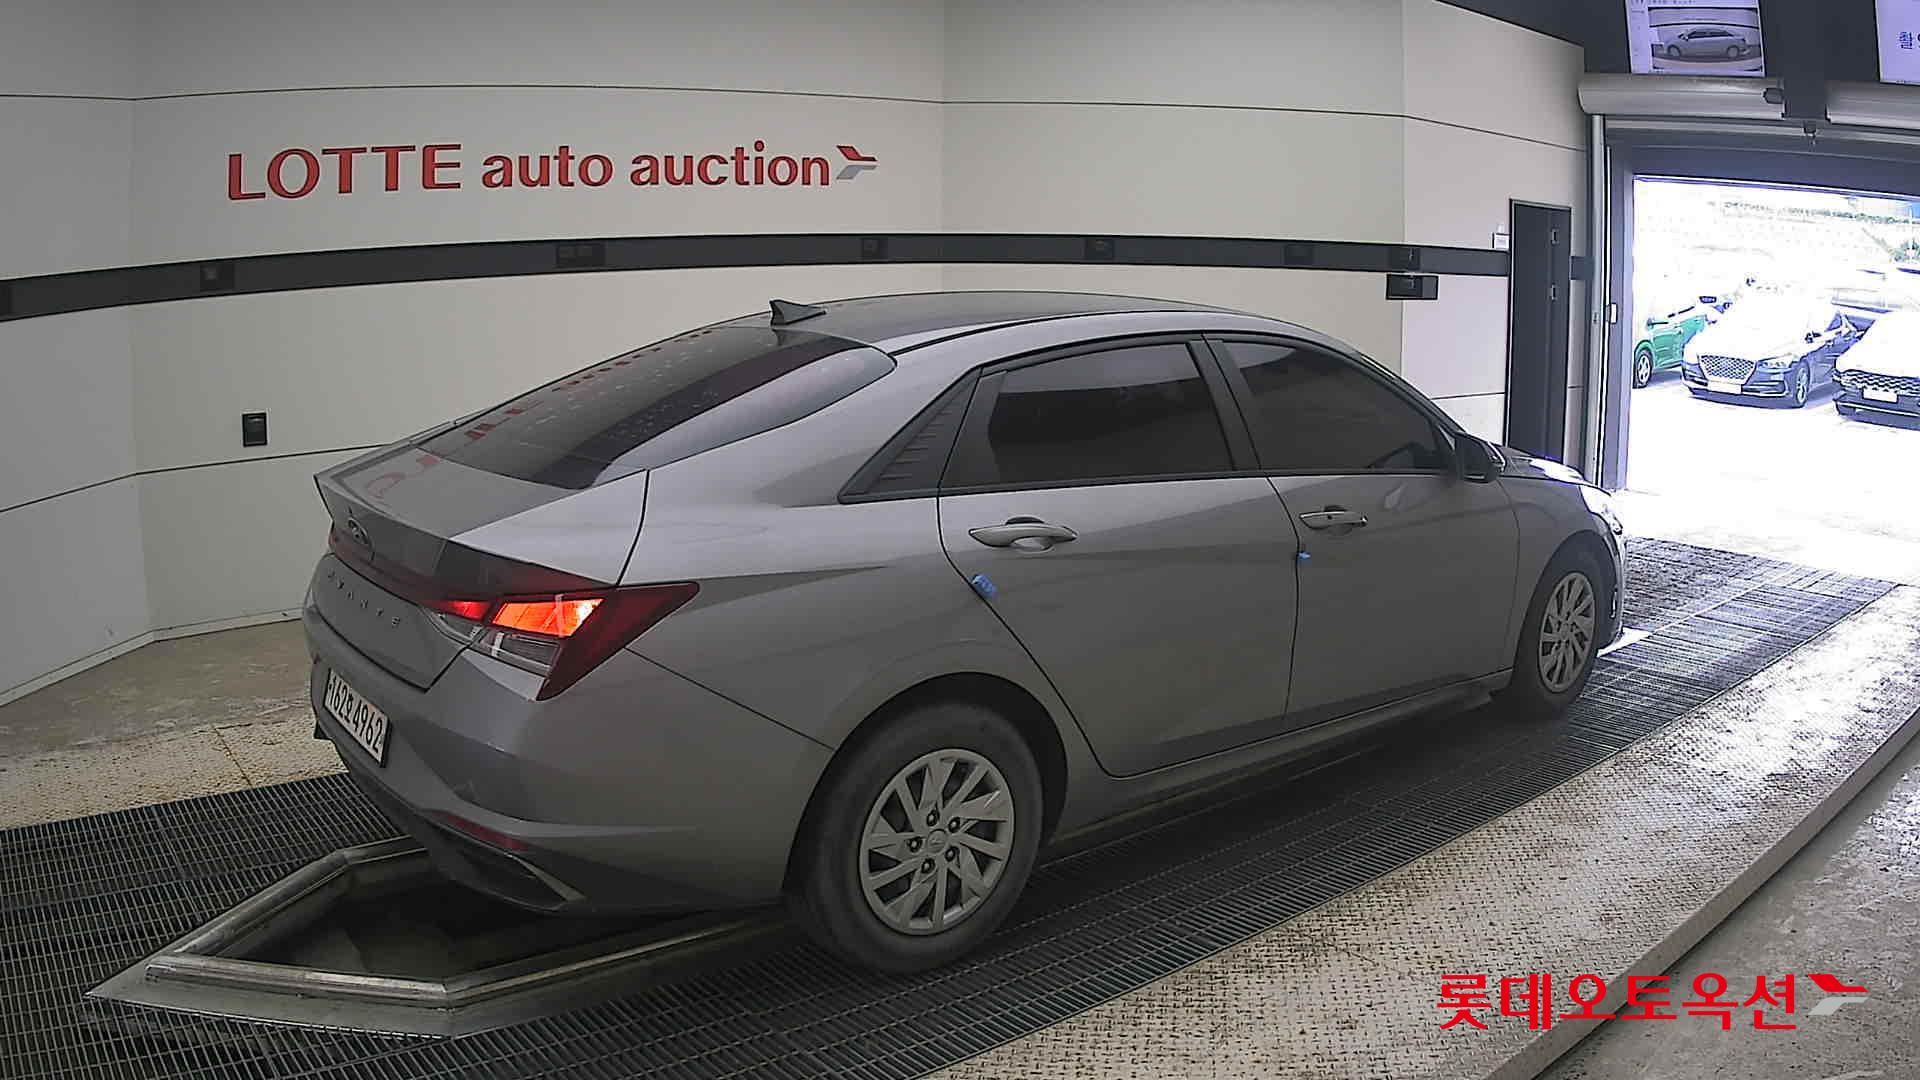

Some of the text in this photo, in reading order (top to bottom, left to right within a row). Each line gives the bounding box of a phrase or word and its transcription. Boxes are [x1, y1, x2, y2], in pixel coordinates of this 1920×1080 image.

[228, 141, 831, 200] LOTTE auto auction
[353, 699, 383, 753] 4962
